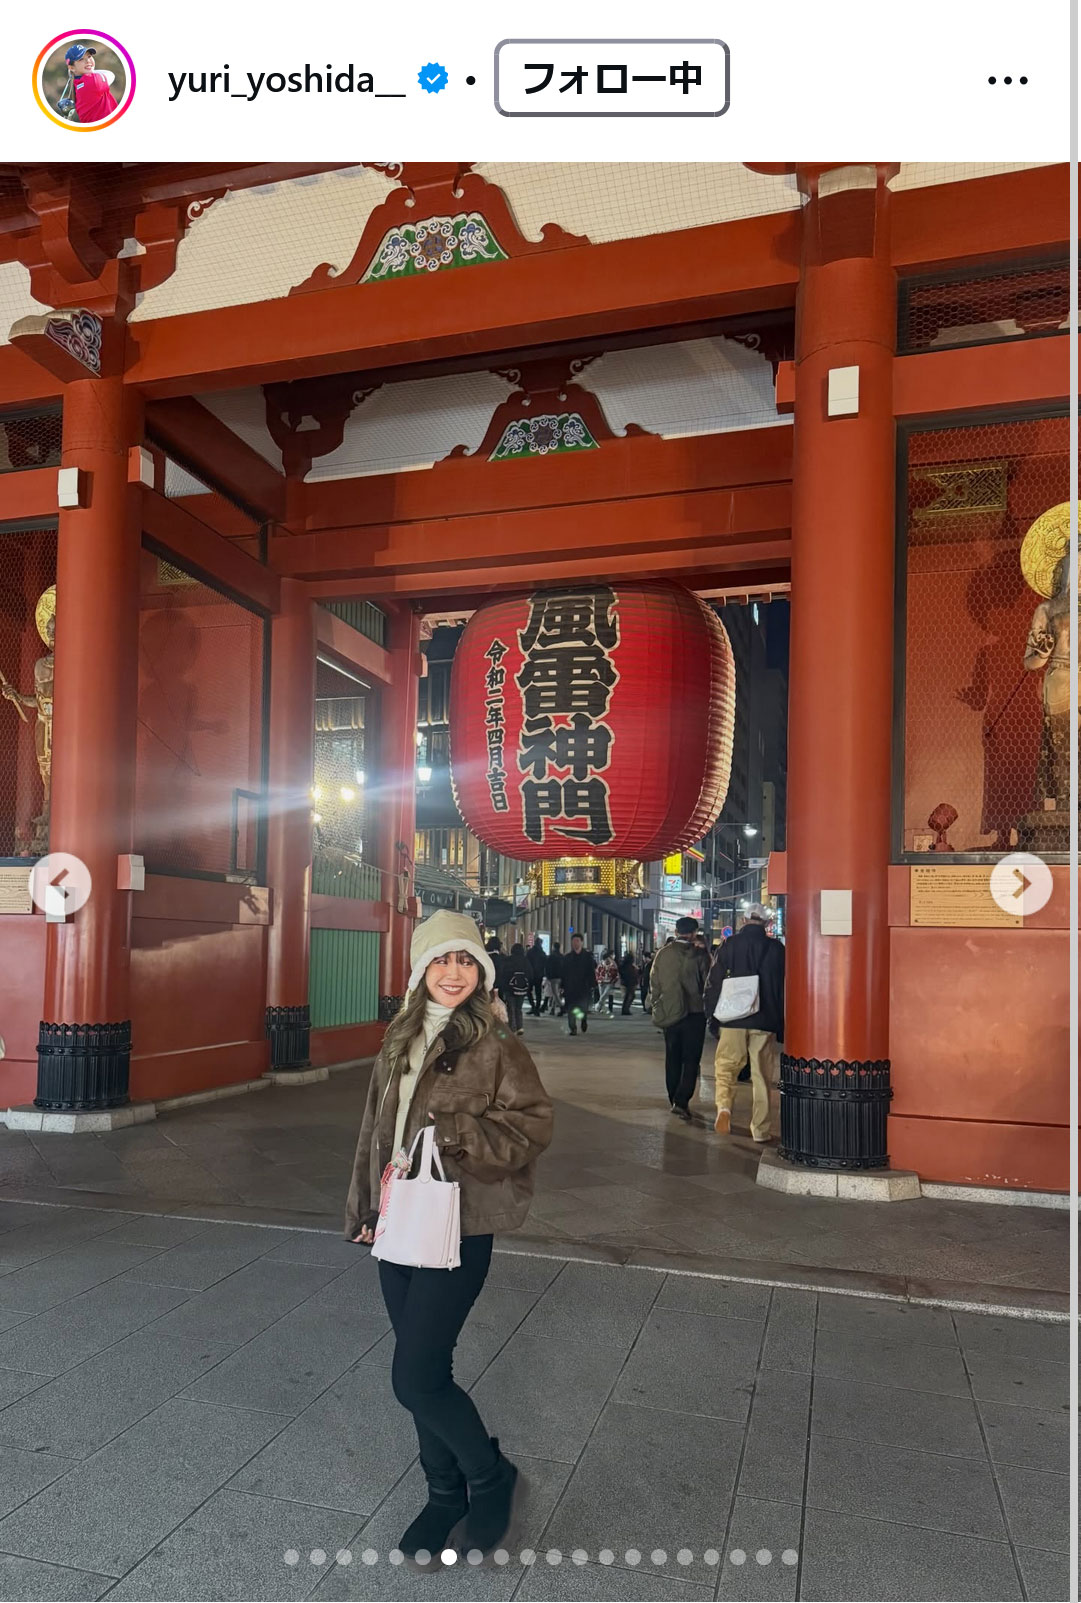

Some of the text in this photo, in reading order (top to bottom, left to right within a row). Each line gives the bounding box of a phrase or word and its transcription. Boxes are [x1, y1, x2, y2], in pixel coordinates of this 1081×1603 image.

[484, 638, 510, 814] 令和二年四月吉日
[514, 583, 620, 845] 風雷神門
